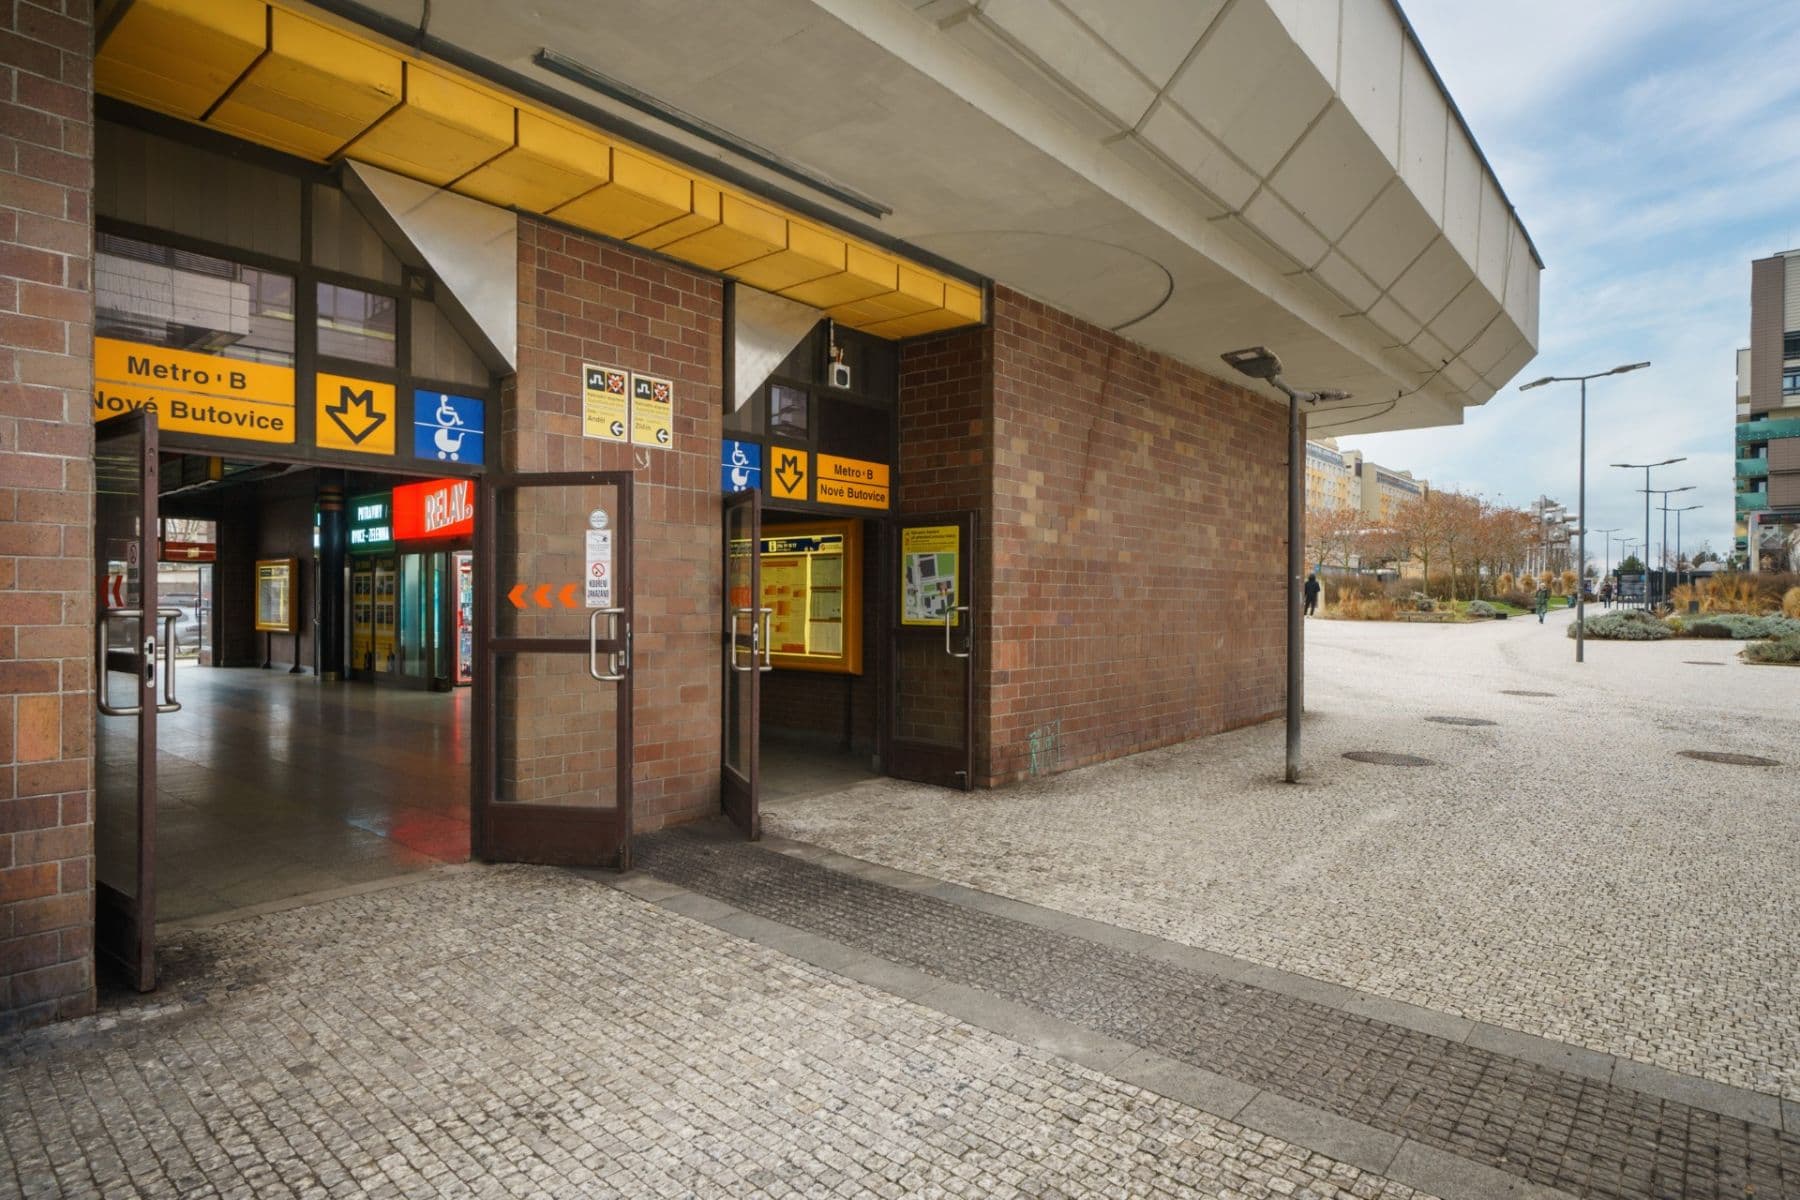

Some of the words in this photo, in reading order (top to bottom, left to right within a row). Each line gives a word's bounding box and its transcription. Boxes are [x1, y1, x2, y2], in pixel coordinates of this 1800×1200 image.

[128, 356, 209, 385] Metro
[230, 371, 246, 390] B
[170, 400, 285, 431] Butovice
[834, 463, 861, 478] Metro
[866, 469, 873, 480] B
[424, 480, 468, 533] RELAY
[820, 483, 844, 497] Nové
[847, 487, 886, 502] Butovice
